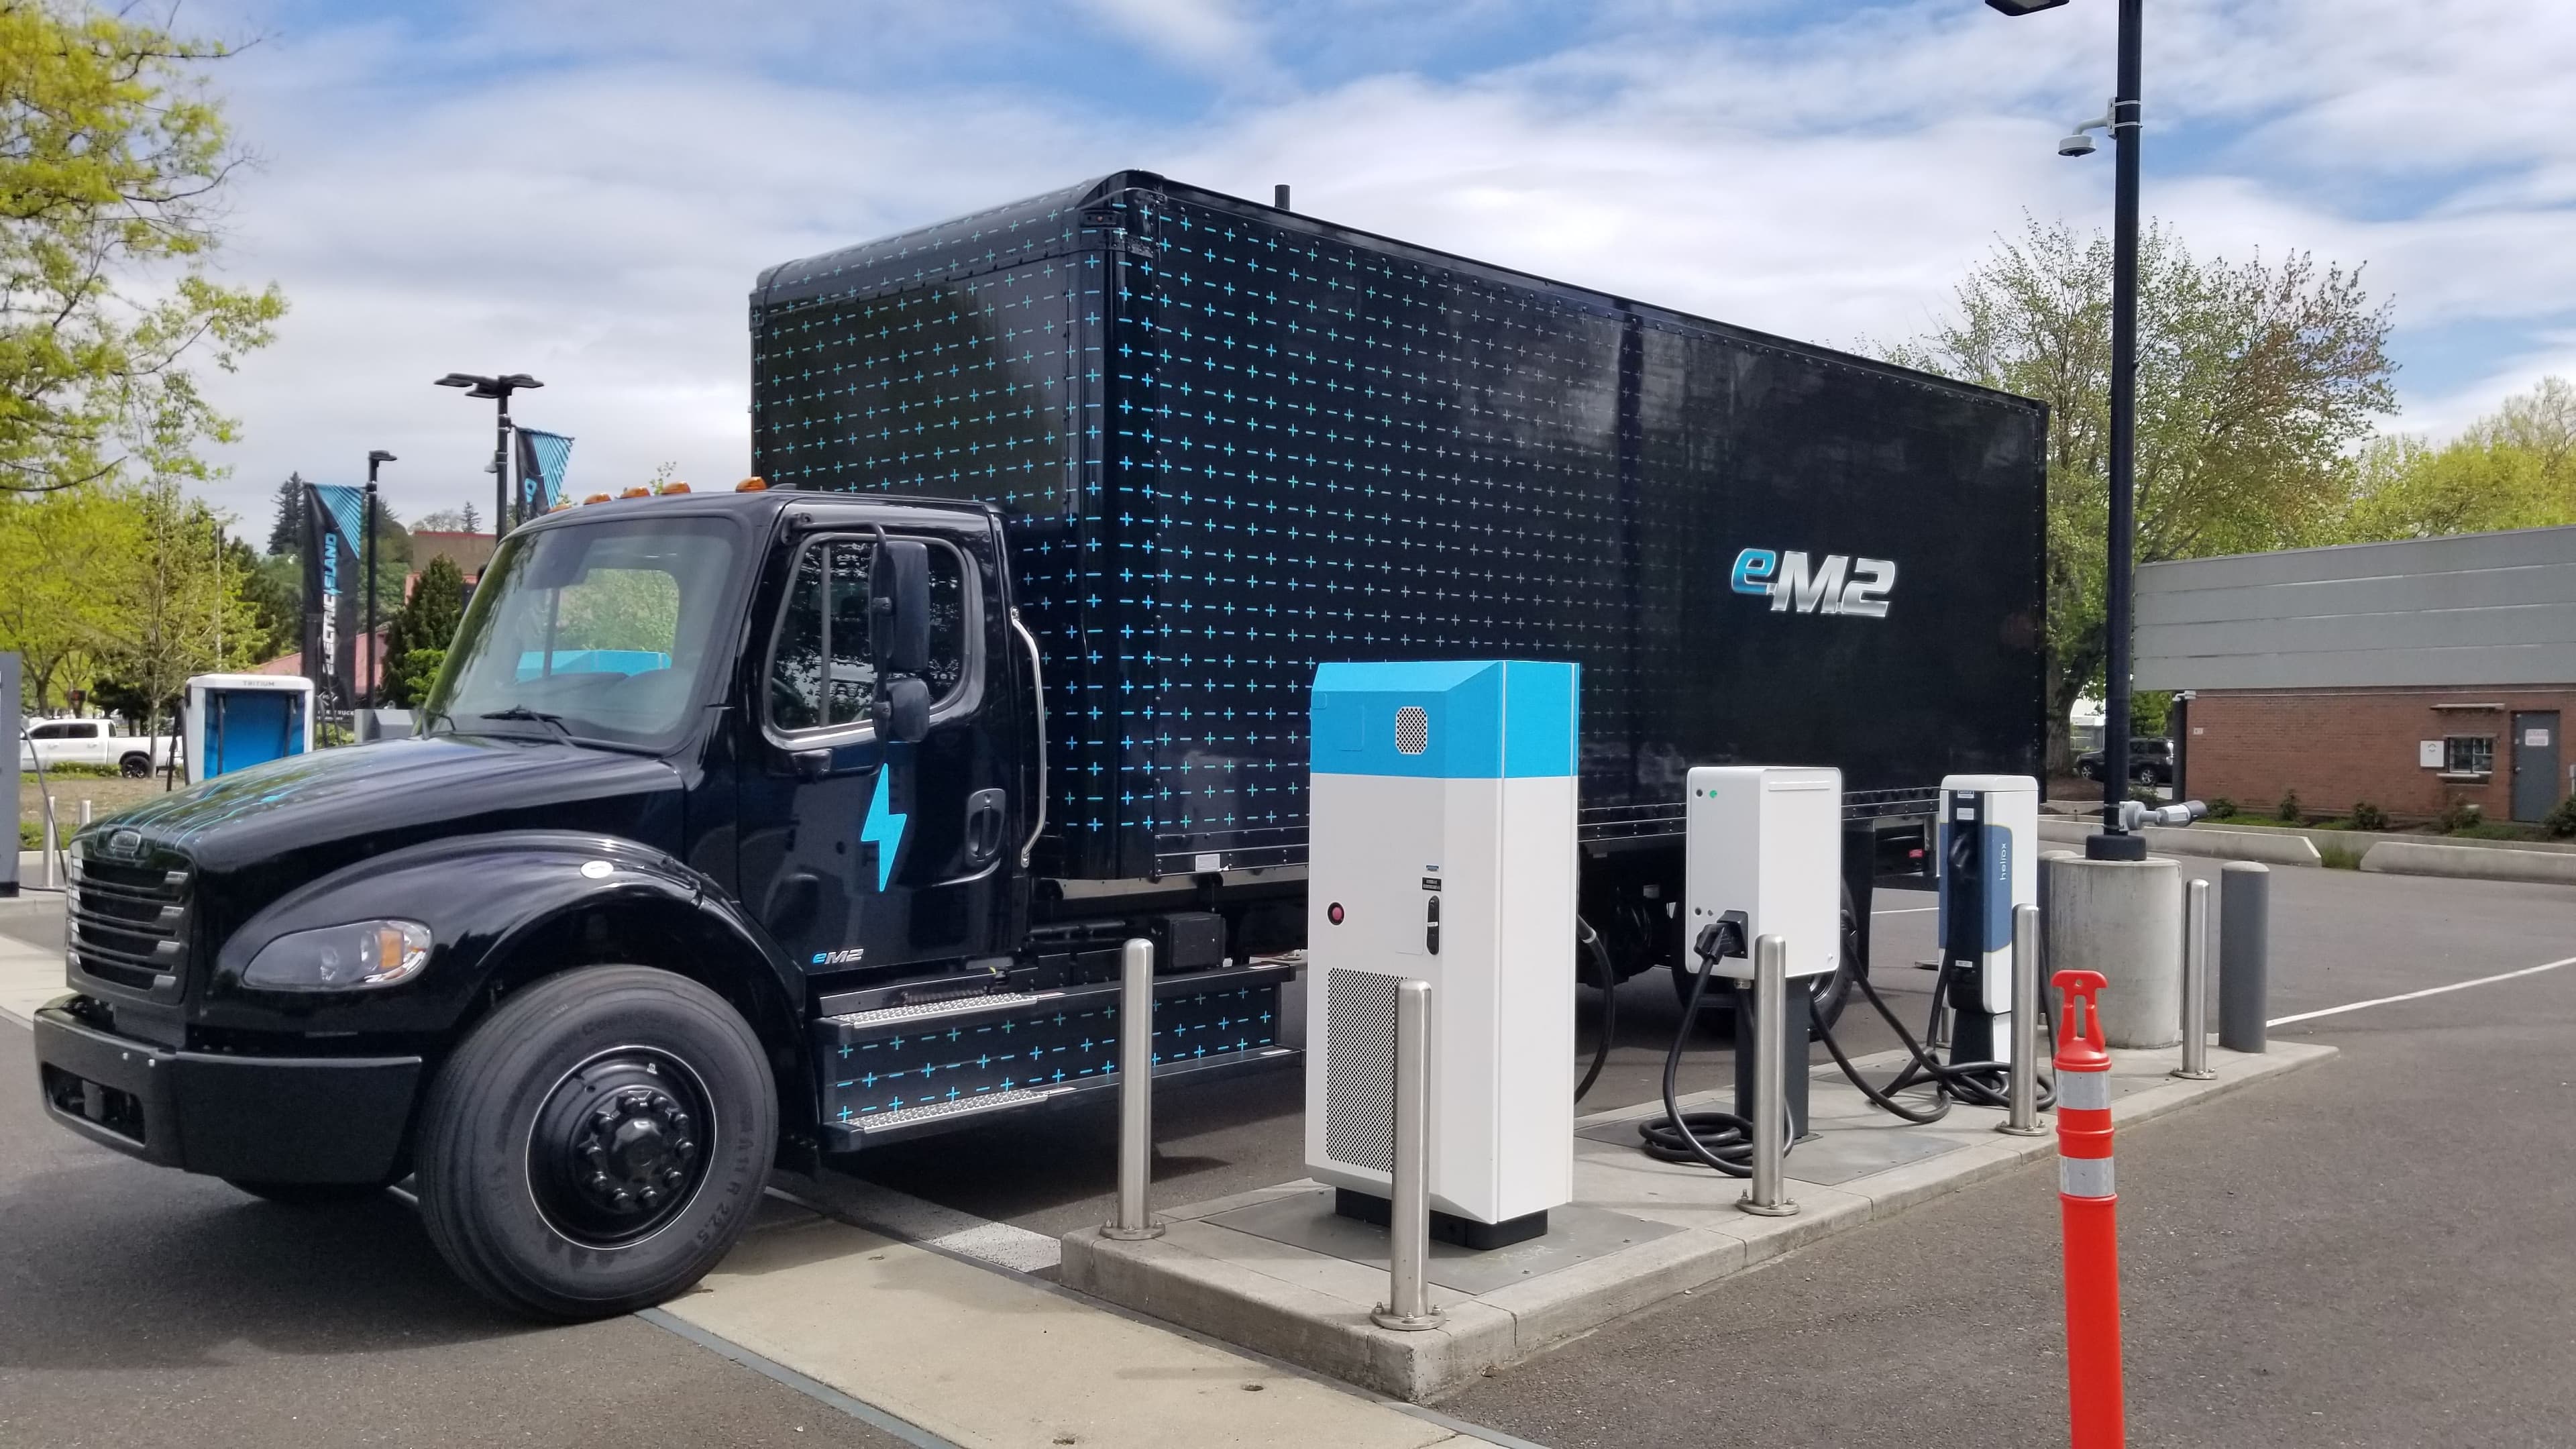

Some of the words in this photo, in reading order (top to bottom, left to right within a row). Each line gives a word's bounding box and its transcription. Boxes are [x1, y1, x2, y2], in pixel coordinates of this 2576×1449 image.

[1731, 548, 1896, 617] eM2
[323, 594, 335, 675] ELECTRIC
[812, 949, 864, 965] eM2
